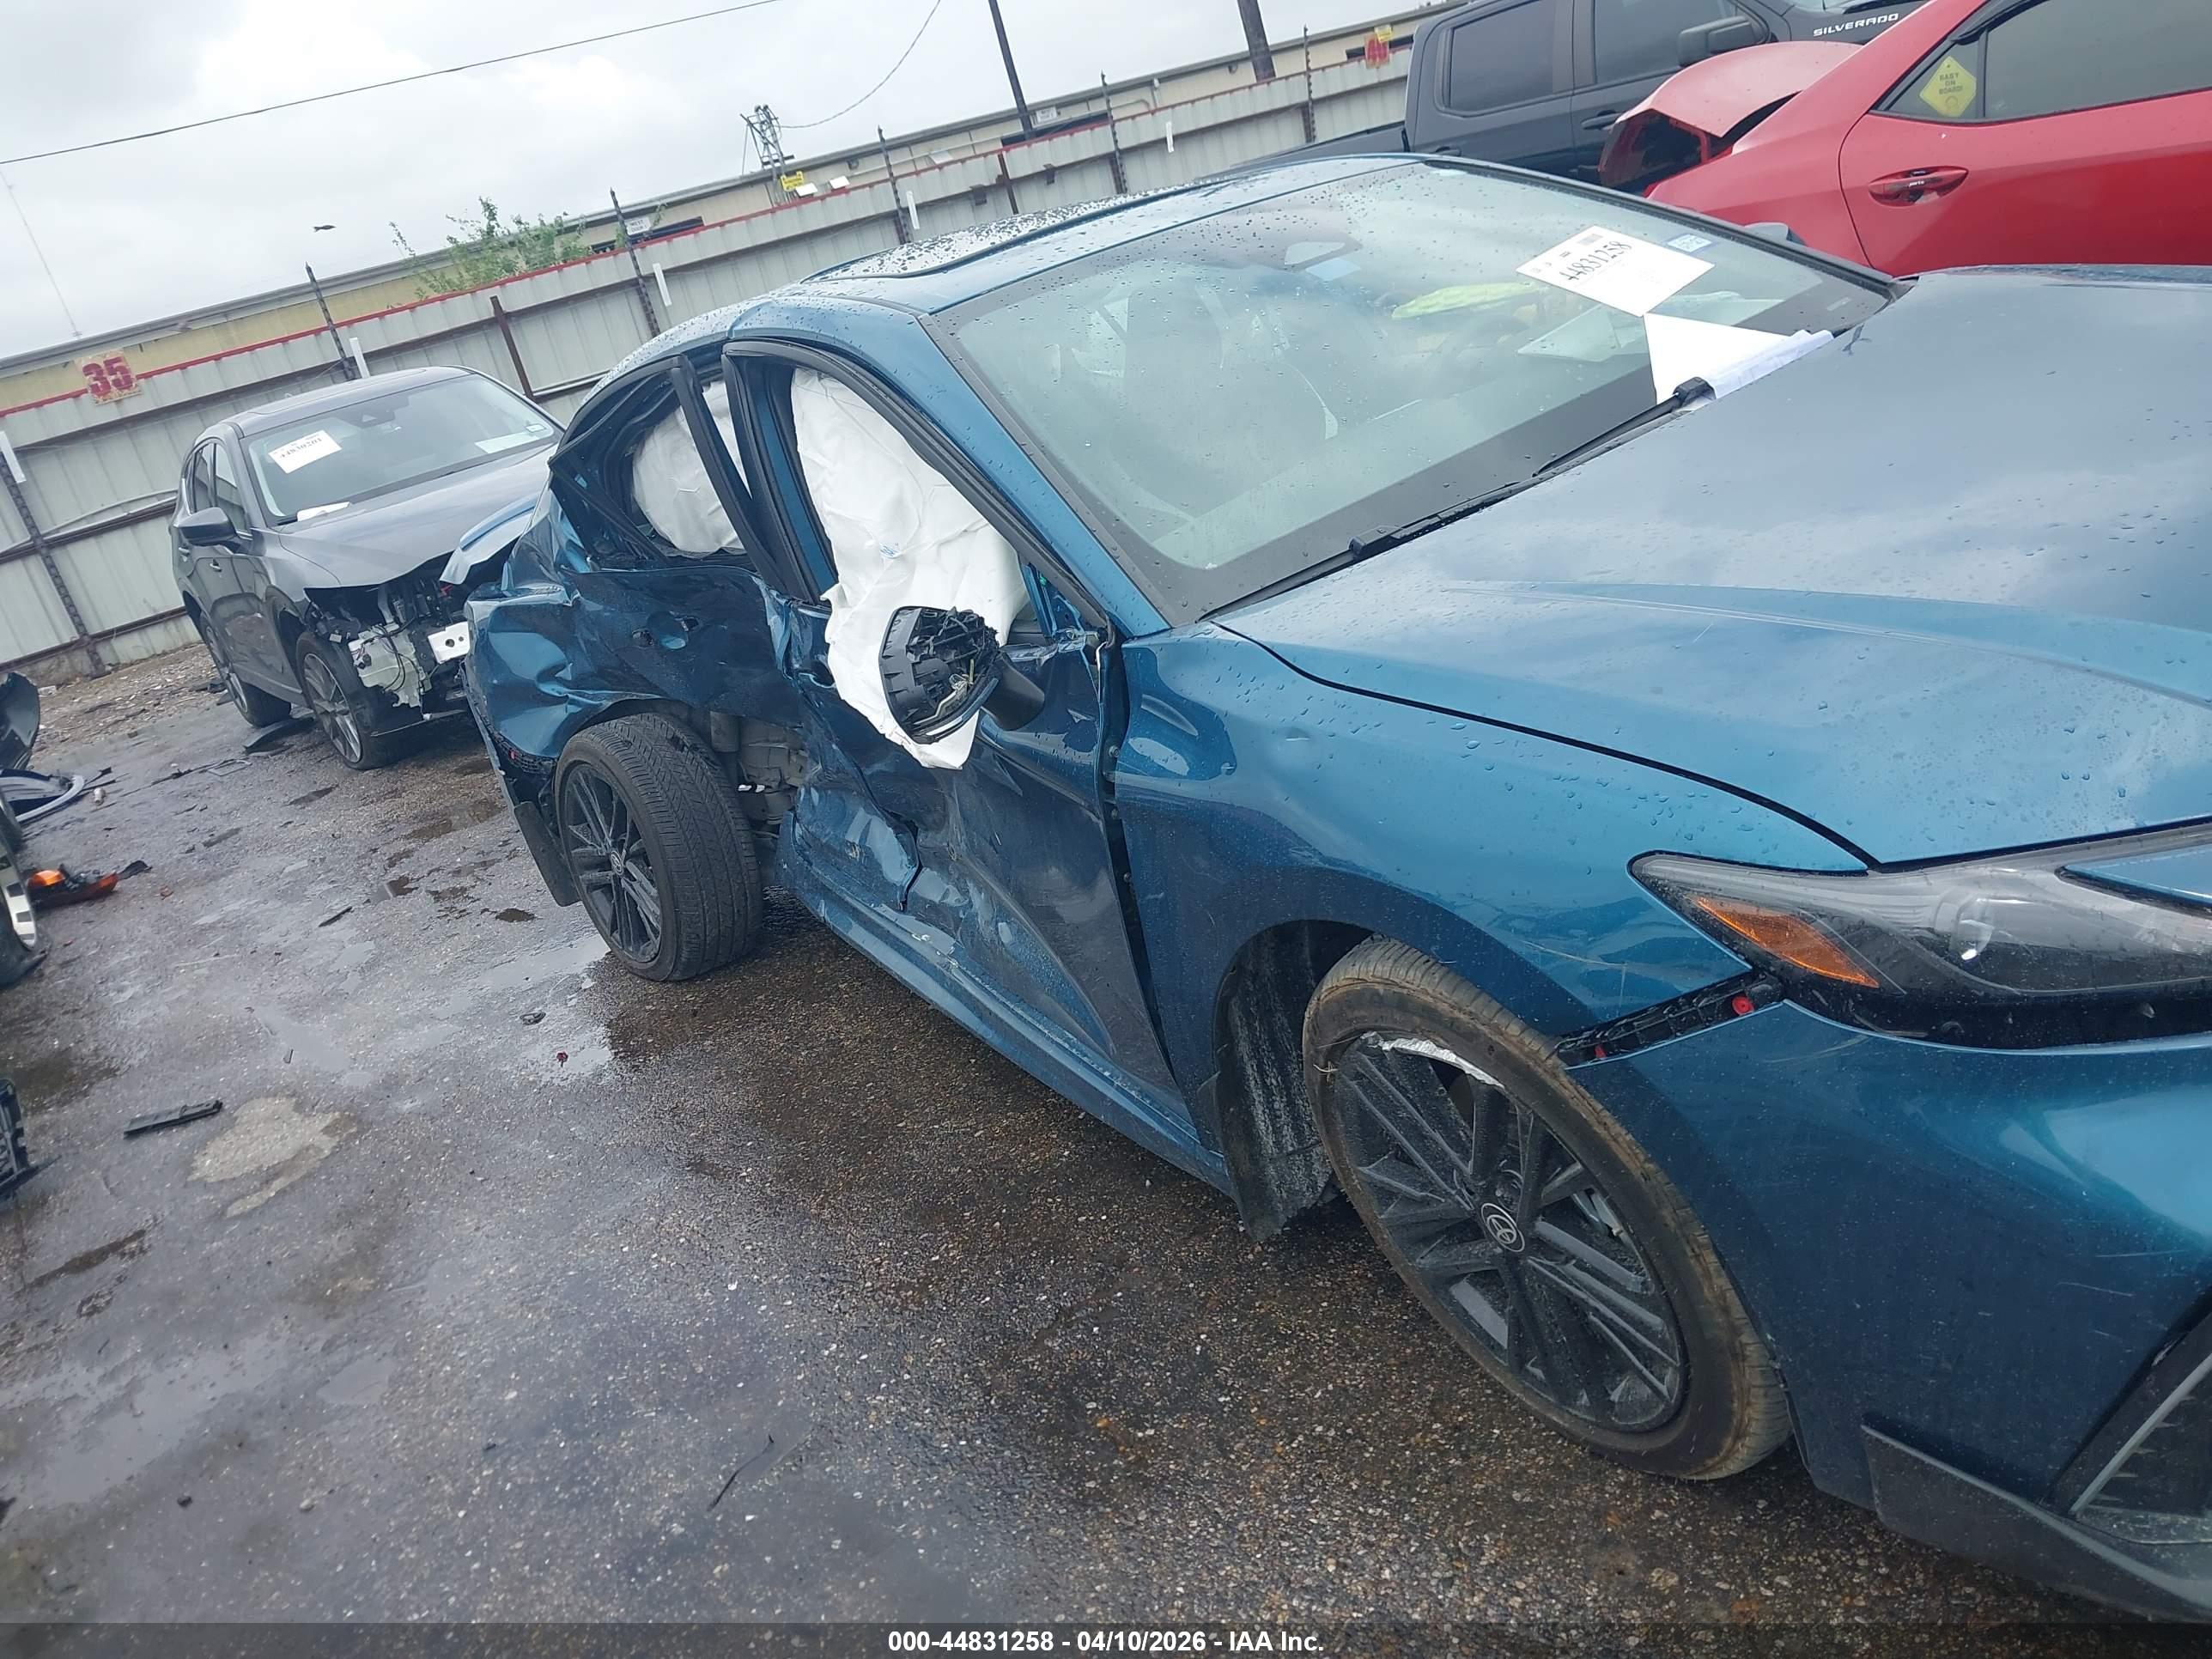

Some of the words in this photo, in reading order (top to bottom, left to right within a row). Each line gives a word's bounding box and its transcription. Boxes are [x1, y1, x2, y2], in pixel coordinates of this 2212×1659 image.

[1813, 13, 1899, 37] SILVERADO
[1939, 72, 1960, 82] BABY
[1559, 240, 1632, 281] 44831258
[82, 356, 133, 397] 35
